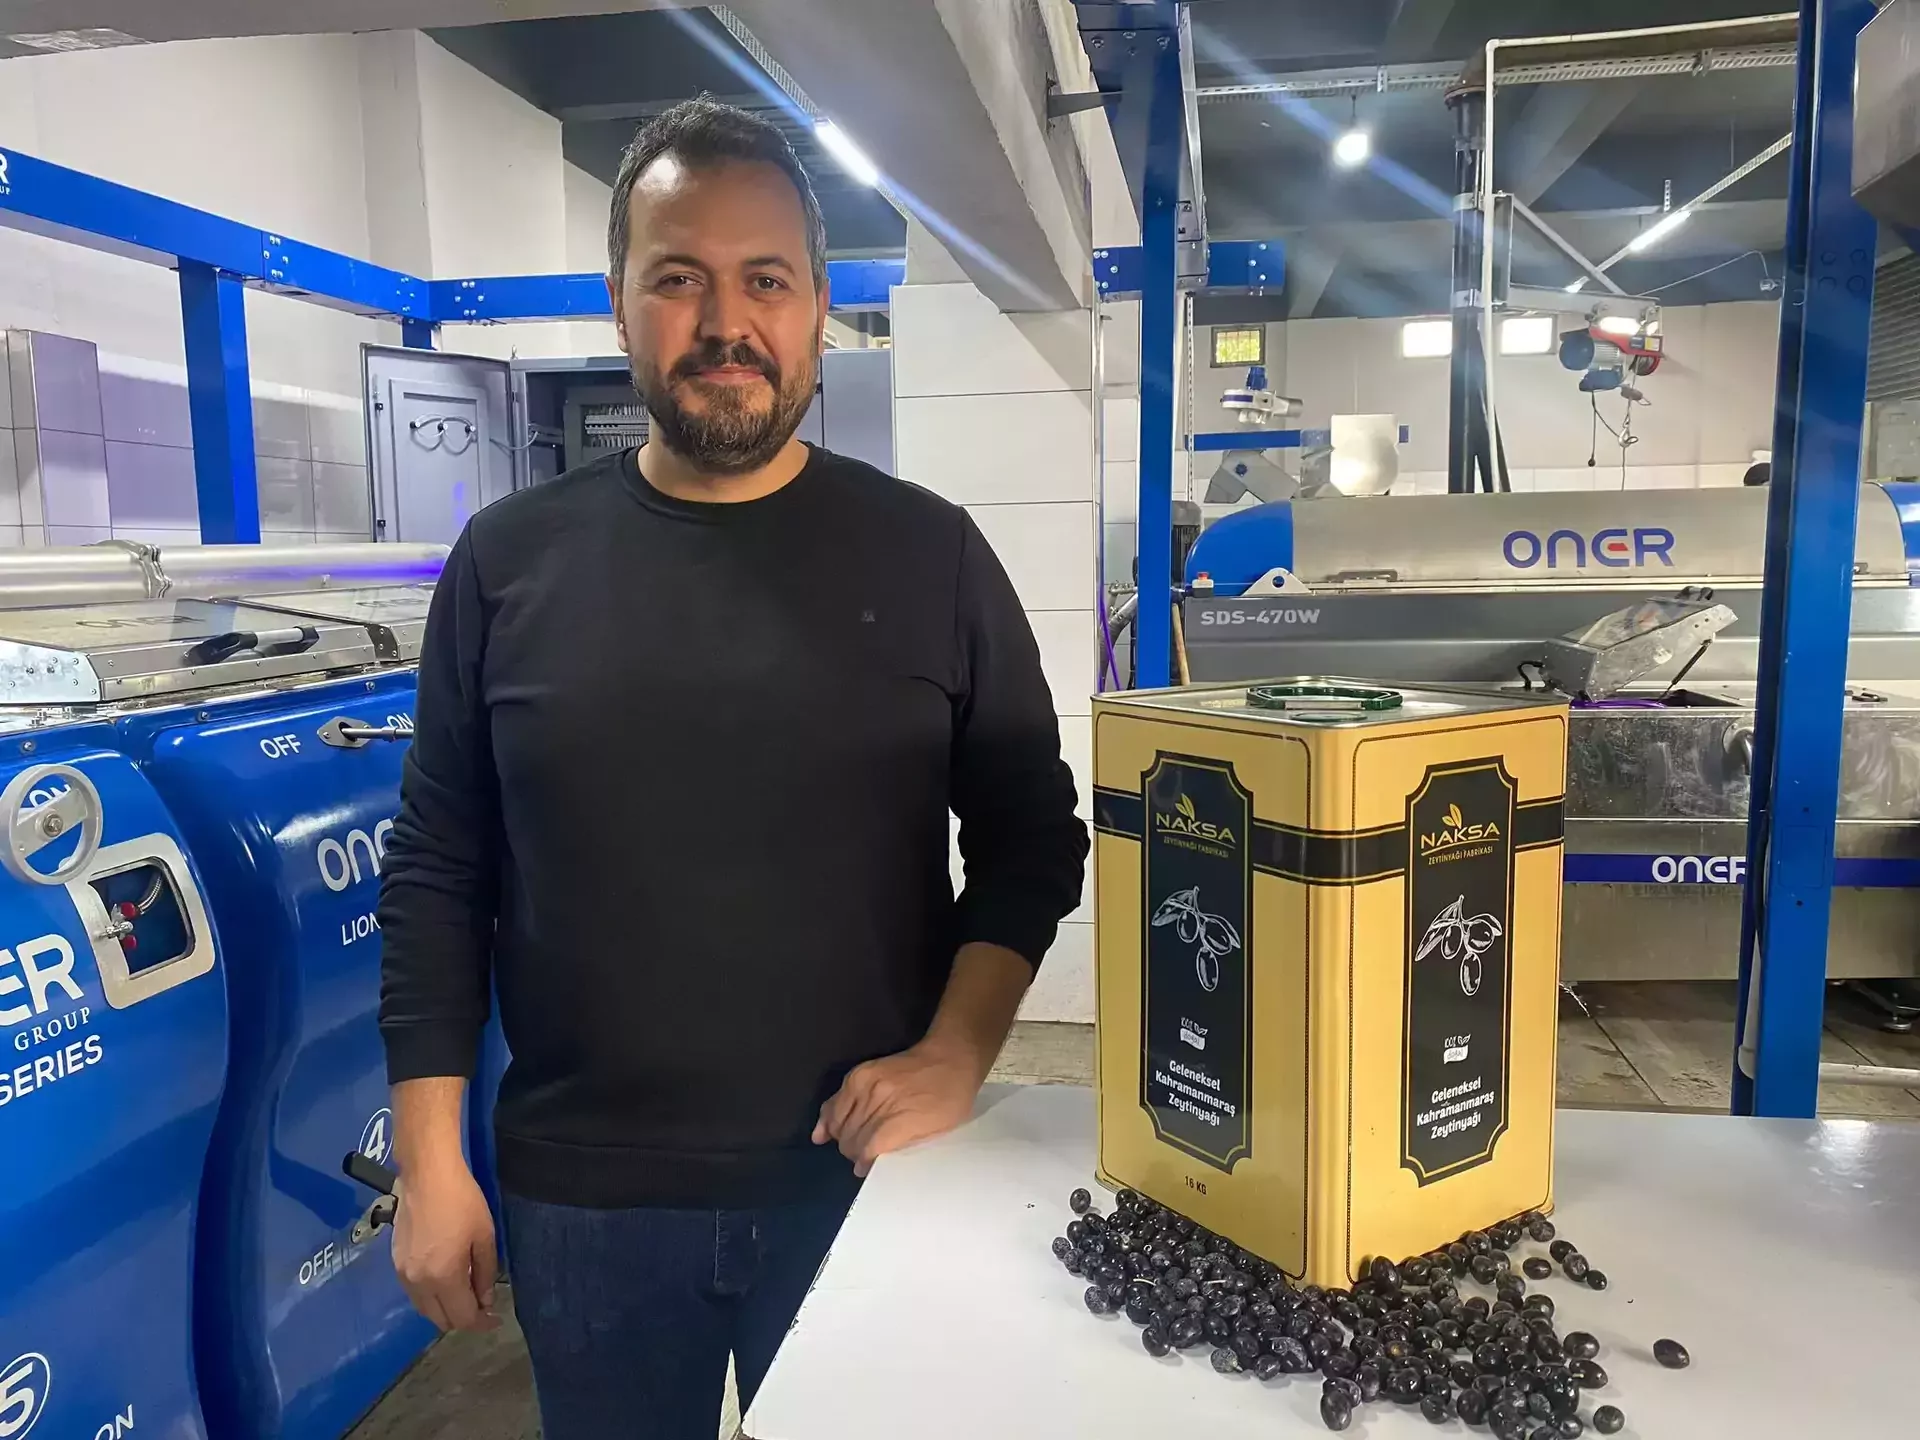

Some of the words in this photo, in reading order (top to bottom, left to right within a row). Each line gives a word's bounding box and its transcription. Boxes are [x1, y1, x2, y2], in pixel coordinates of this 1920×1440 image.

[1503, 528, 1675, 569] ONER
[1200, 608, 1320, 626] SDS-470W
[260, 733, 301, 759] OFF
[1156, 812, 1236, 844] NAKSA
[1421, 821, 1501, 850] NAKSA
[1463, 845, 1494, 859] FABRİKASI
[14, 1006, 91, 1051] GROUP
[0, 1034, 104, 1106] SERIES
[1169, 1060, 1221, 1091] Geleneksel
[1155, 1070, 1236, 1117] Kahramanmaraş
[1431, 1075, 1482, 1104] Geleneksel
[1168, 1092, 1220, 1127] Zeytinyağı
[1416, 1091, 1495, 1127] Kahramanmaraş
[1430, 1110, 1482, 1139] Zeytinyağı
[363, 1117, 386, 1162] 4
[1184, 1175, 1194, 1189] 16
[1196, 1180, 1207, 1195] KG
[299, 1242, 334, 1285] OFF
[0, 1361, 35, 1438] 5
[94, 1403, 134, 1440] ON
